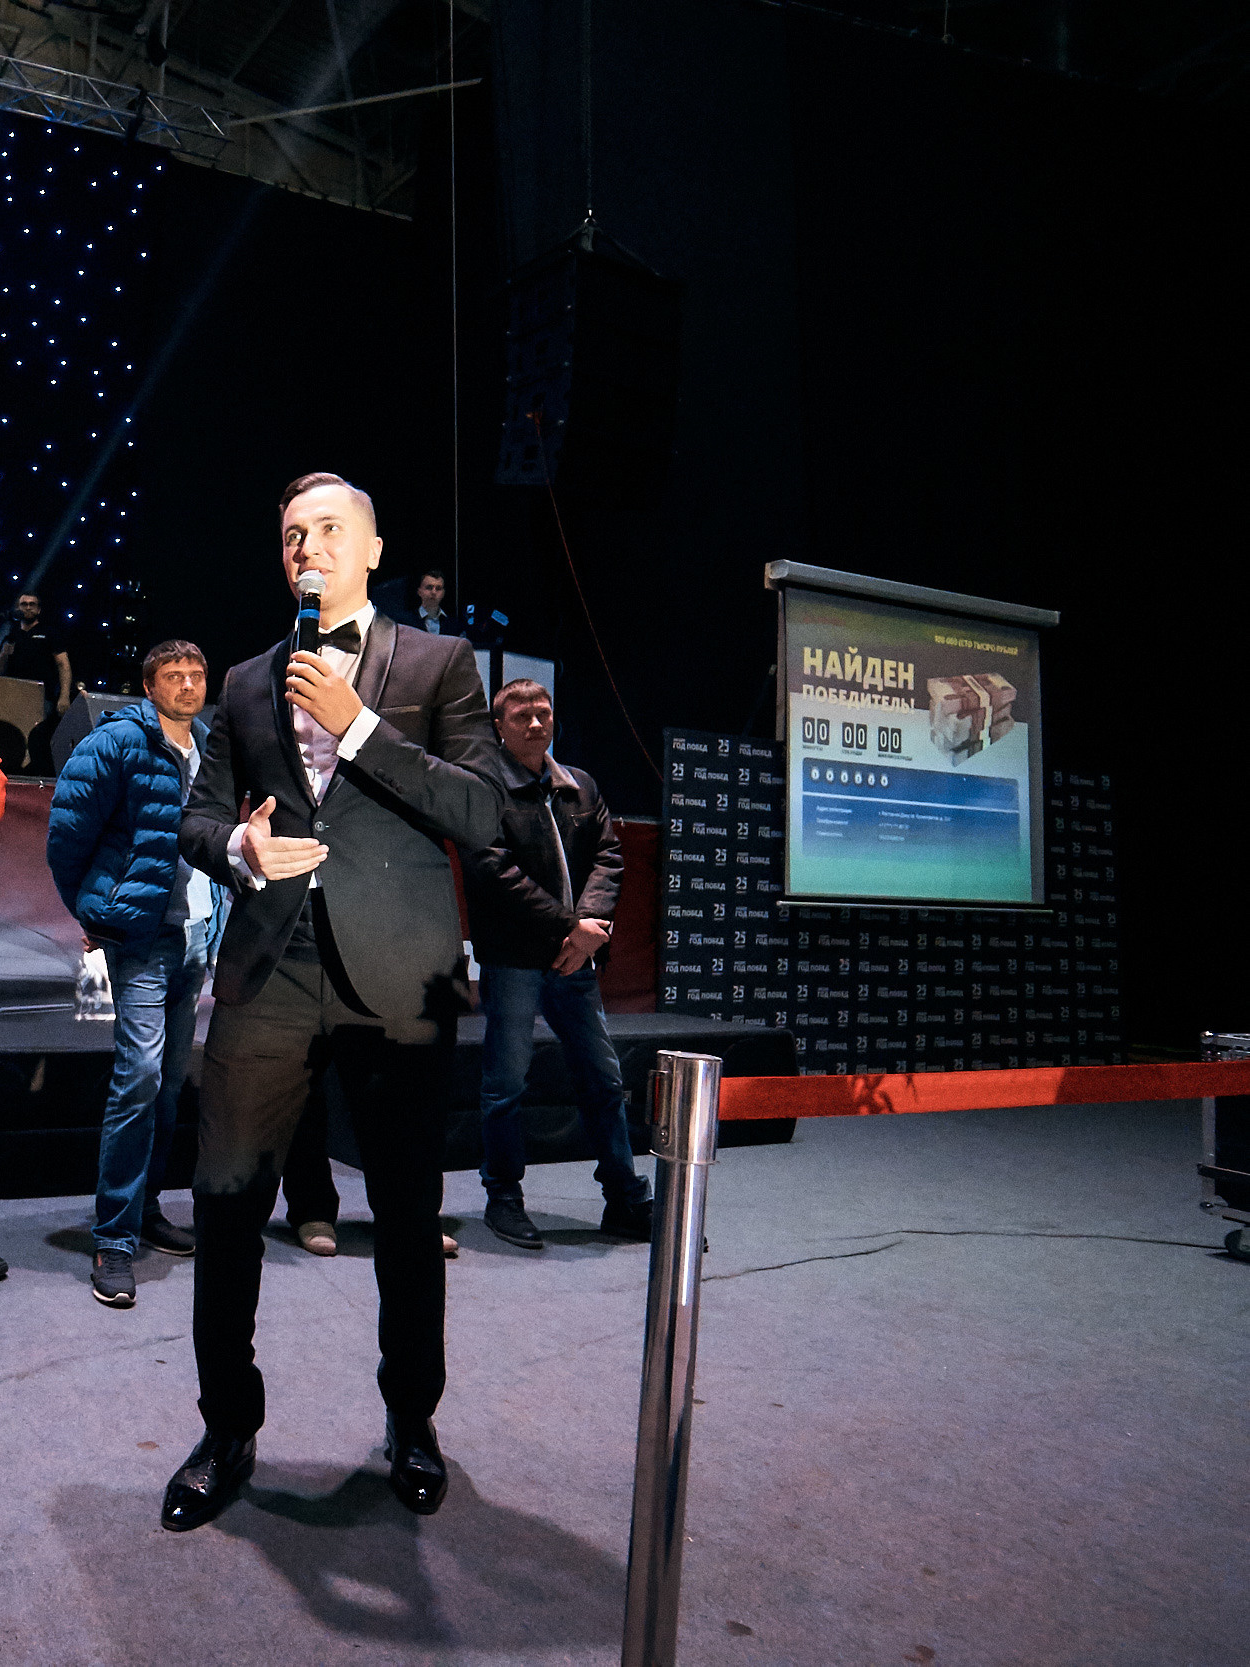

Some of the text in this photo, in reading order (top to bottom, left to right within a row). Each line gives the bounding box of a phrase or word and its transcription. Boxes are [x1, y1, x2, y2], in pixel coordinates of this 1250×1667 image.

[803, 646, 915, 692] НАЙДЕН
[802, 684, 915, 715] ПОБЕДИТЕЛЬ!
[804, 720, 900, 751] 00 00 00
